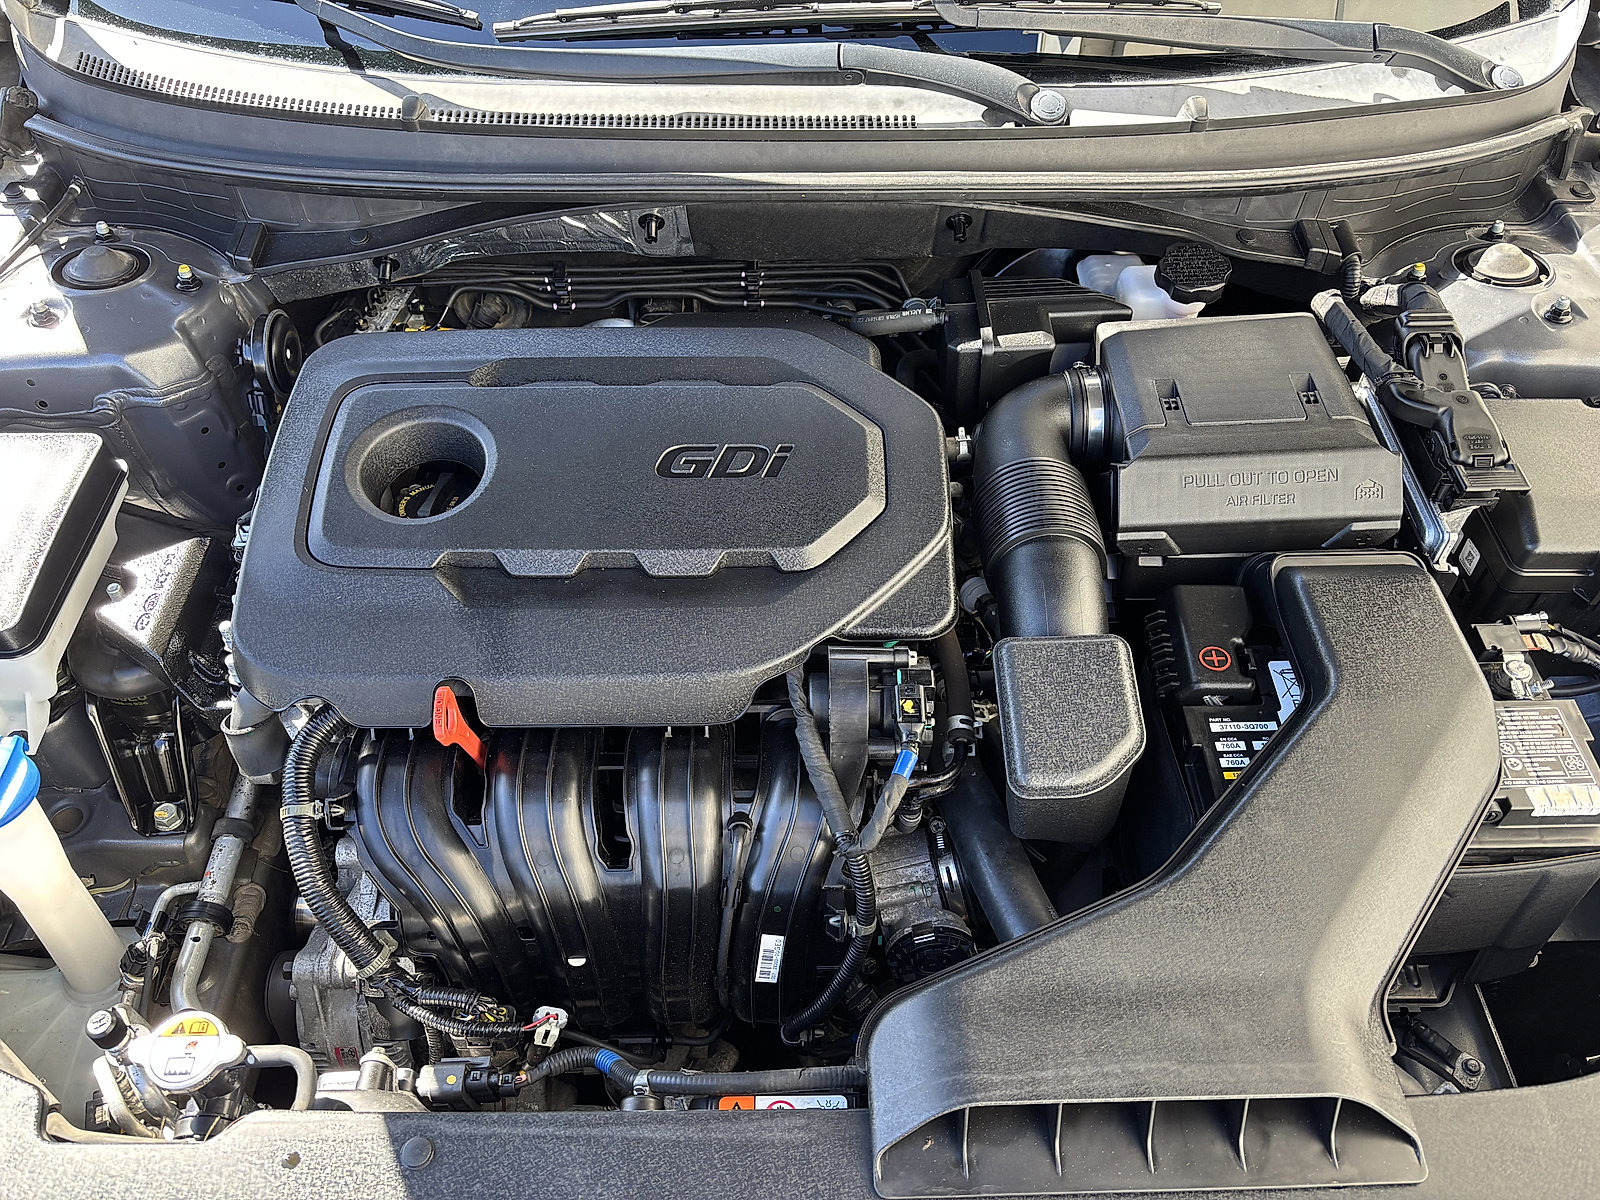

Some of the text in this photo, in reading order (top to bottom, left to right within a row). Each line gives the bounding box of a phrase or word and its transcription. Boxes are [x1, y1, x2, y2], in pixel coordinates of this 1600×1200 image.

[655, 443, 796, 479] GDi
[1182, 467, 1340, 489] PULL OUT TO OPEN
[409, 483, 438, 497] MANUA
[1225, 492, 1296, 507] AIR FILTER
[435, 692, 445, 726] ENG OIL
[1219, 723, 1269, 731] 37110-3Q700
